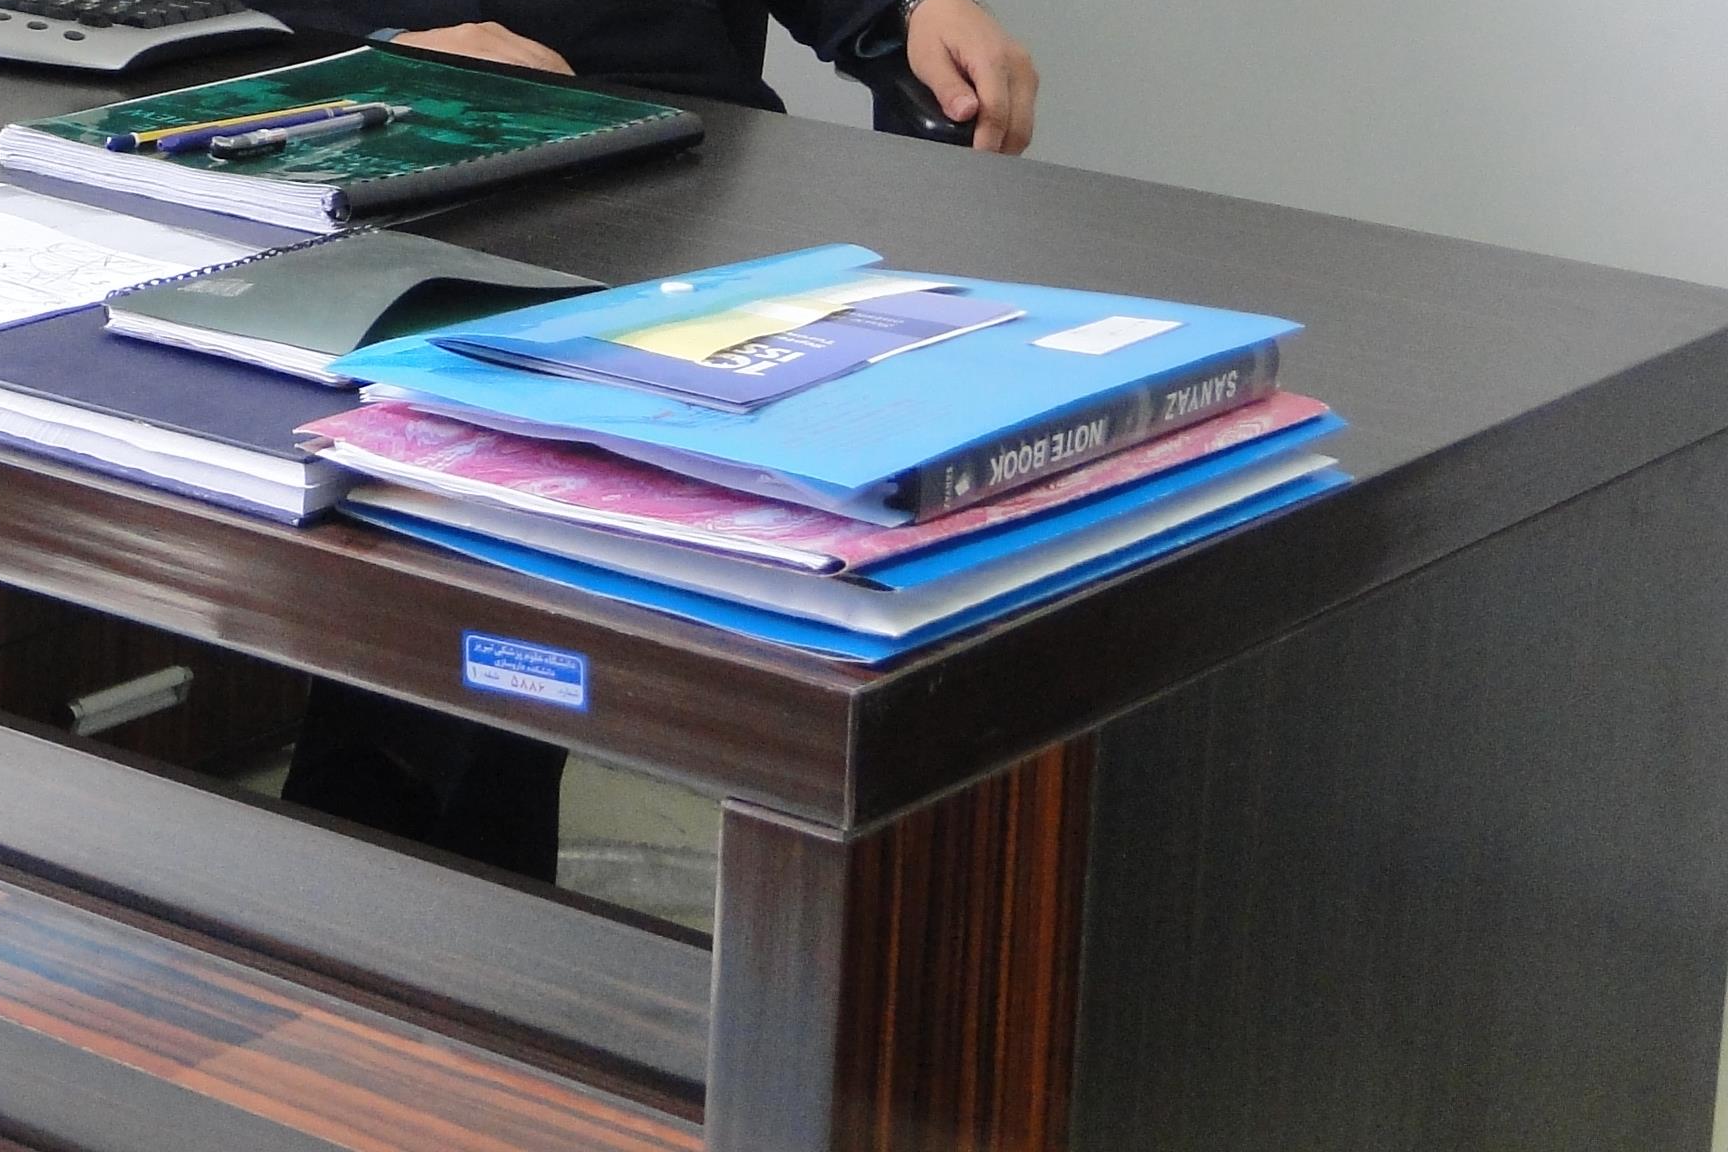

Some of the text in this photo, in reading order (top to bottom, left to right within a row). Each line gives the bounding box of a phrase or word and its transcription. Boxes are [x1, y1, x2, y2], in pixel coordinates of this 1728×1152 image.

[988, 369, 1239, 486] SANYAZ NOTE BOOK
